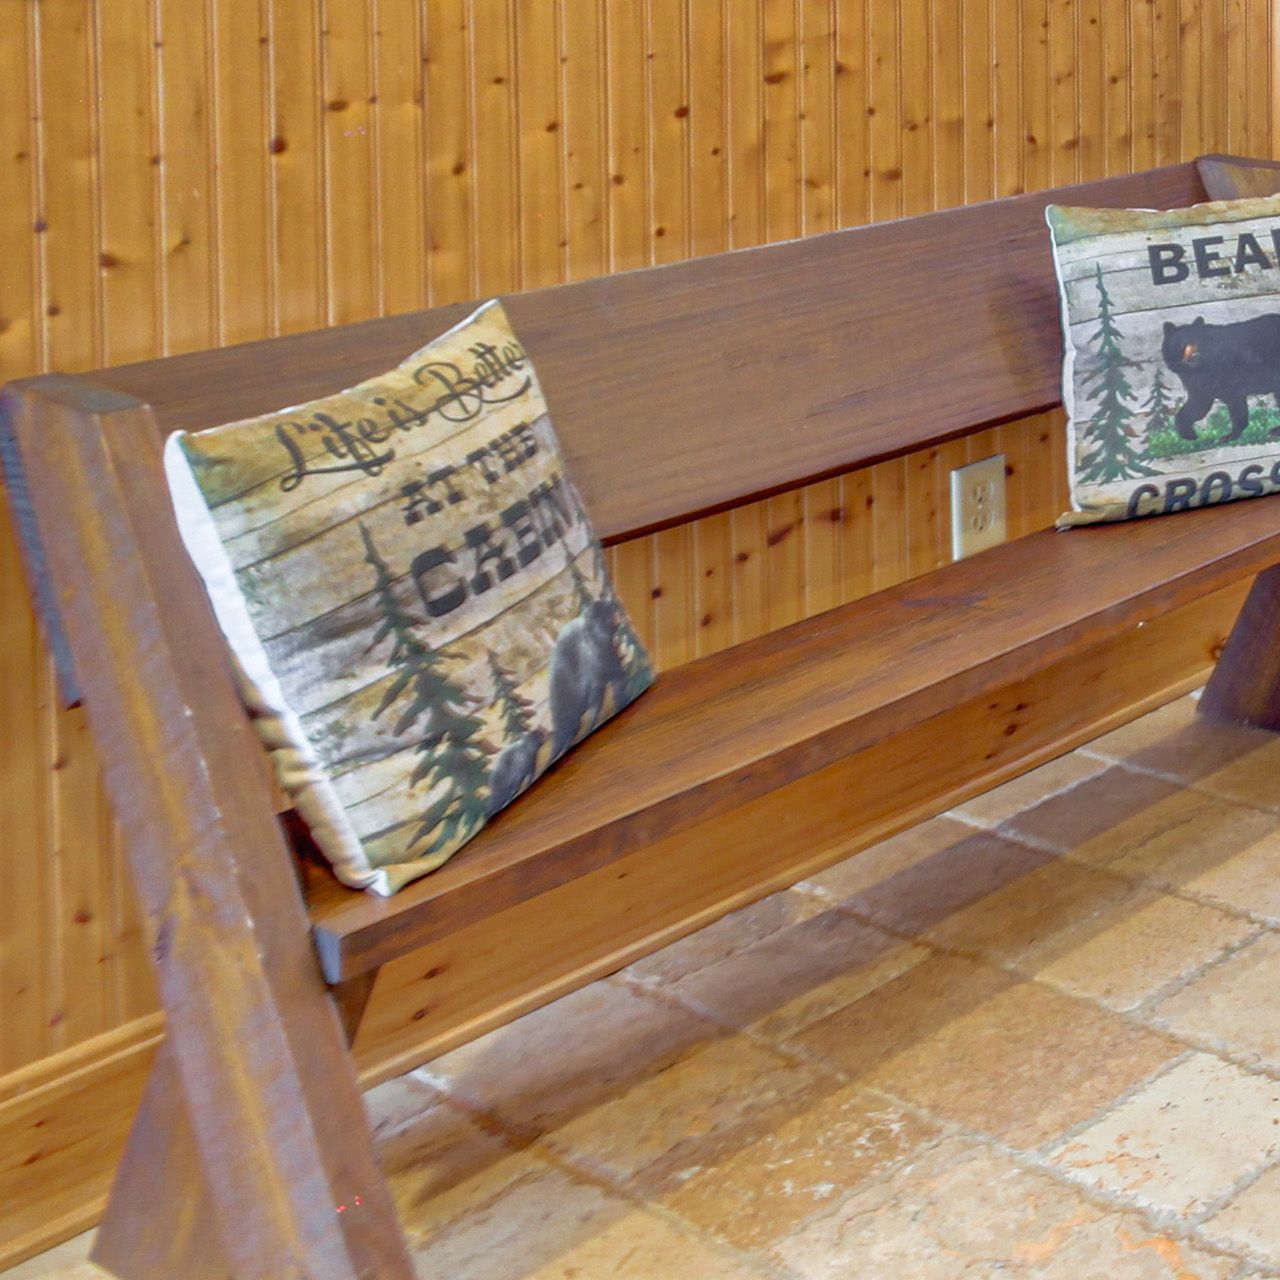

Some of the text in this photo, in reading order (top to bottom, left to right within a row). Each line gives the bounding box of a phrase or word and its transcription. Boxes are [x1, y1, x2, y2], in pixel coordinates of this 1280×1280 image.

[277, 413, 396, 492] Life
[373, 396, 429, 431] is
[401, 422, 538, 526] AT THE
[411, 473, 575, 617] CABIN
